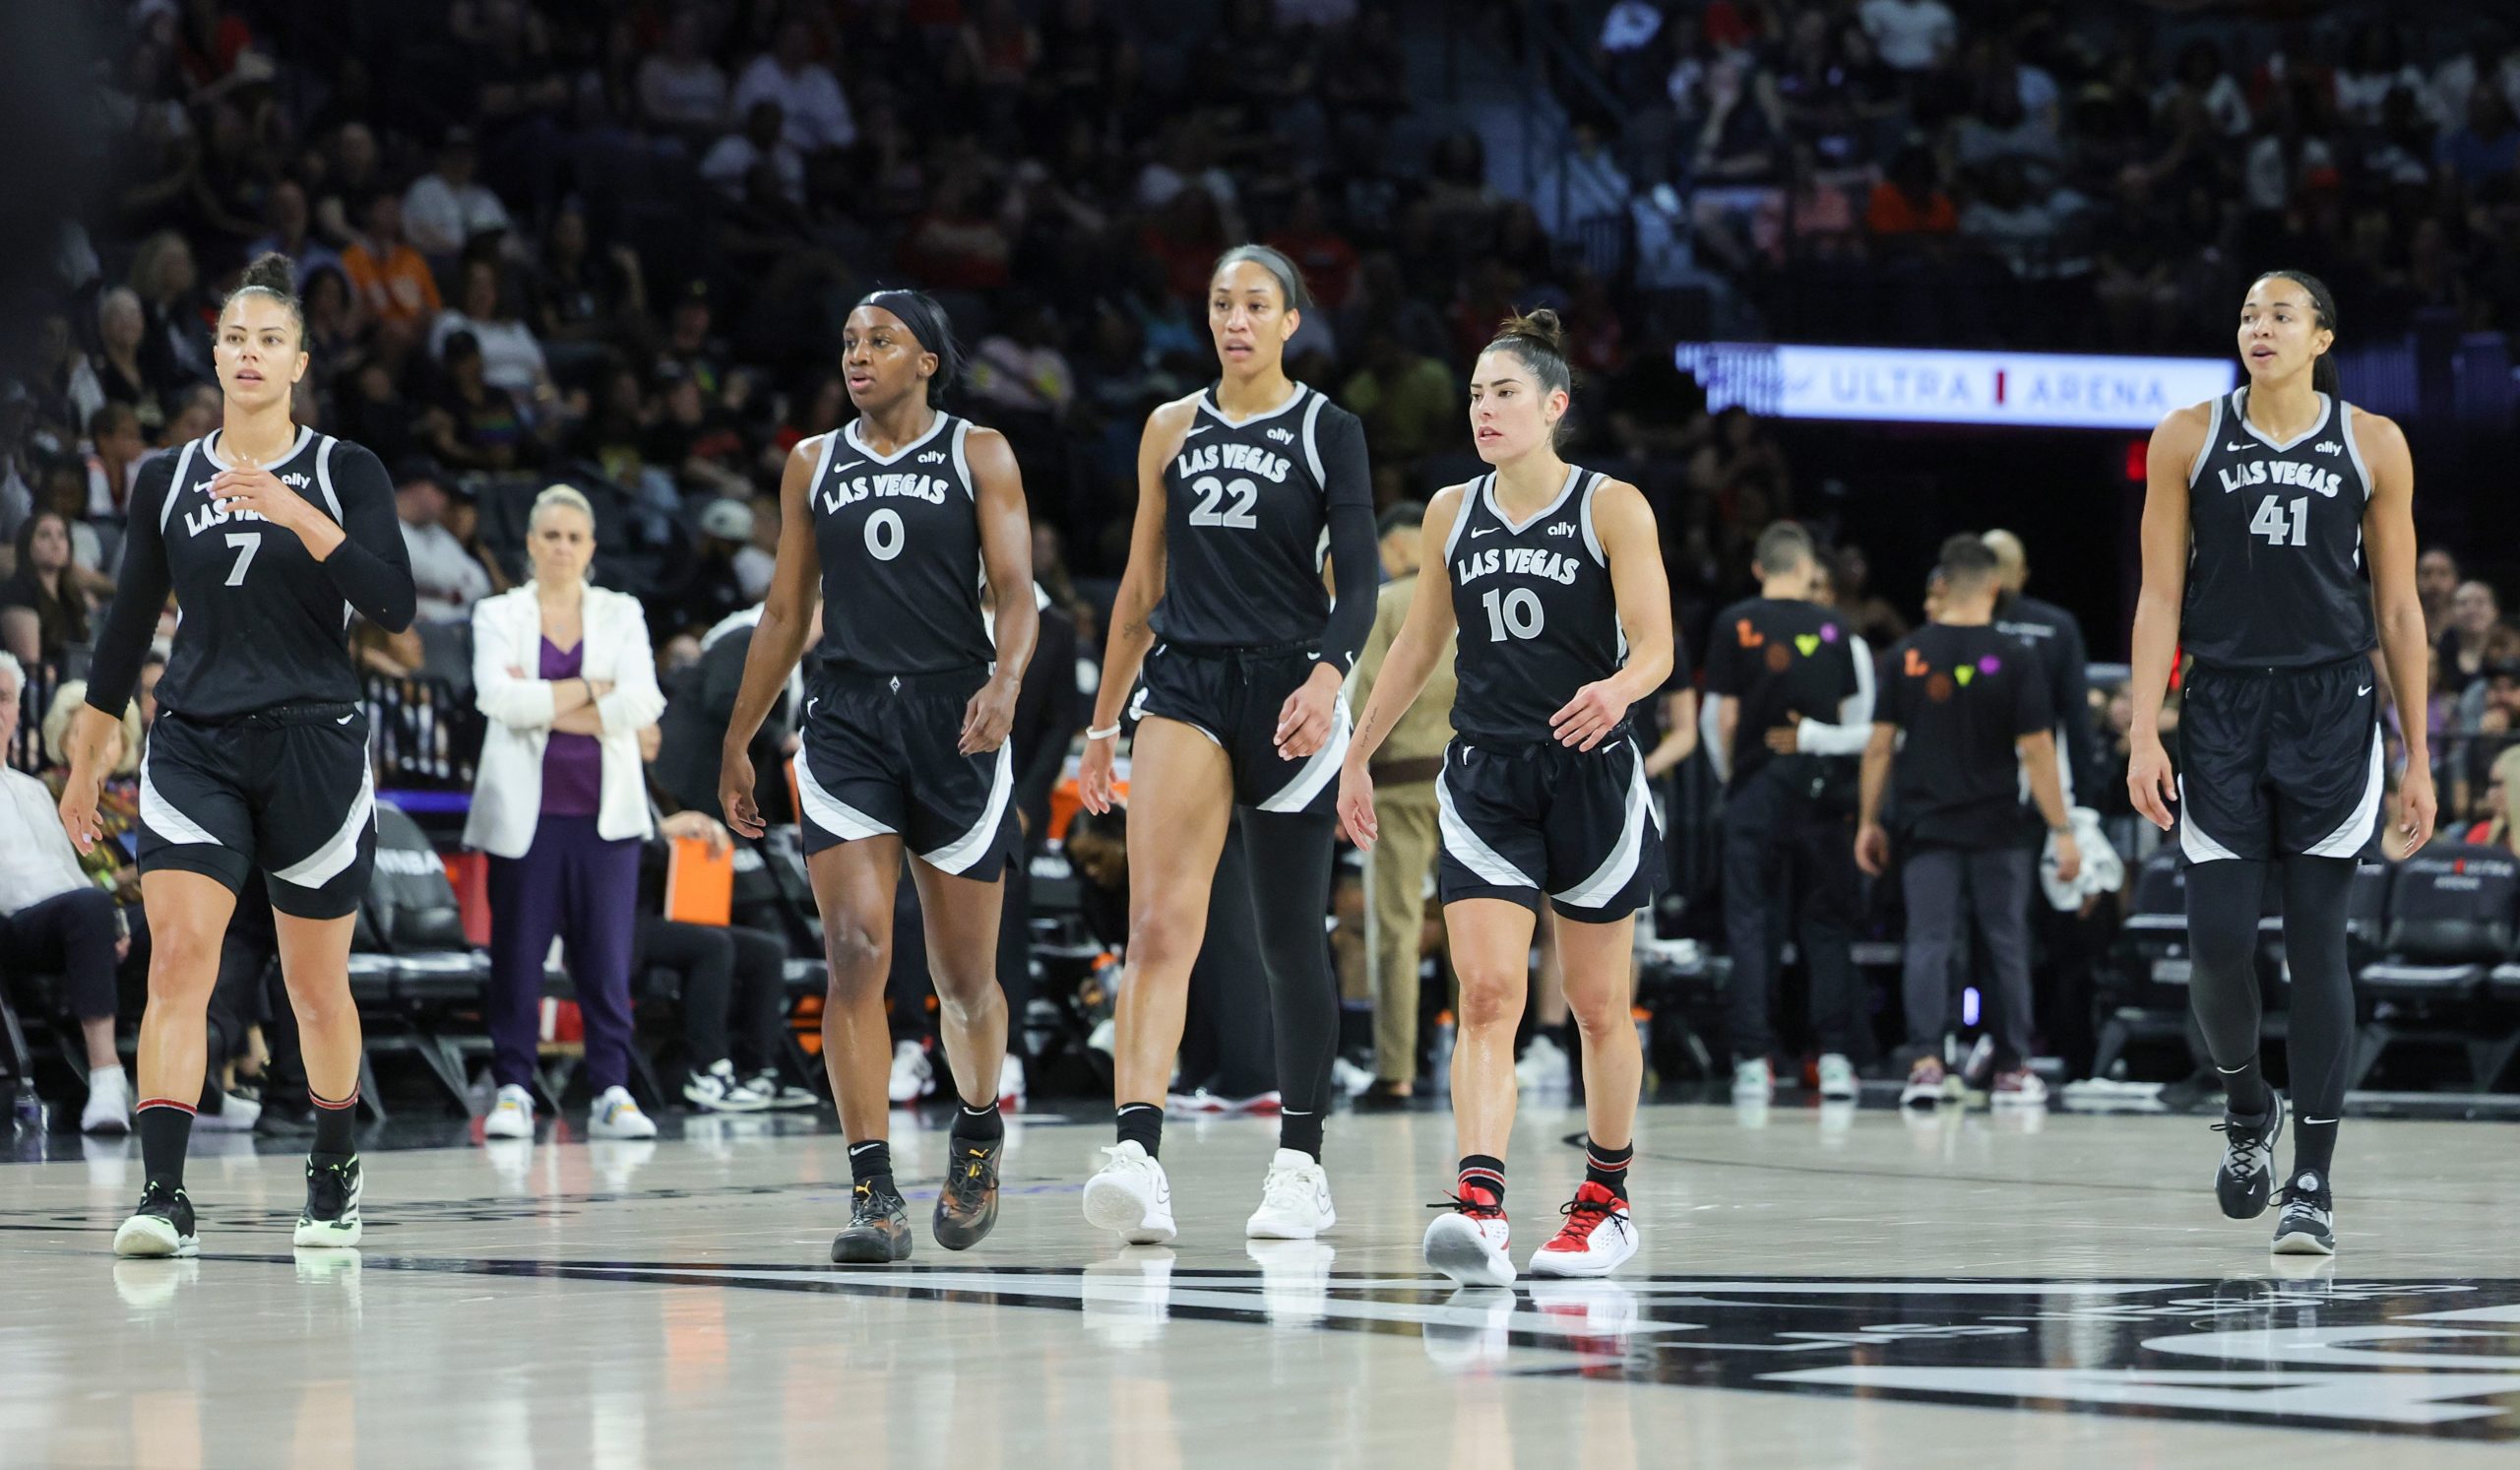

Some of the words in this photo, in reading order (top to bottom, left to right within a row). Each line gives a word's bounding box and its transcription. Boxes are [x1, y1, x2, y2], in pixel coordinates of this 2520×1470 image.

[1830, 367, 1972, 404] ULTRA
[2028, 375, 2168, 411] ARENA
[1266, 427, 1294, 445] ally
[2314, 441, 2342, 457] ally
[917, 450, 947, 465] ally
[1177, 444, 1219, 479] LAS
[1223, 443, 1292, 483] VEGAS
[281, 473, 311, 489] ally
[822, 477, 869, 515] LAS
[872, 473, 949, 505] VEGAS
[2218, 461, 2267, 493] LAS
[2269, 461, 2343, 498] VEGAS
[184, 497, 227, 538] LAS
[1189, 476, 1258, 530] 22
[2249, 494, 2308, 546] 41
[864, 508, 905, 561] 0
[1547, 522, 1576, 538] ally
[224, 532, 261, 586] 7
[1457, 548, 1500, 586] LAS
[1504, 548, 1580, 585] VEGAS
[1482, 587, 1544, 642] 10
[1981, 1283, 2479, 1321] VEGAS
